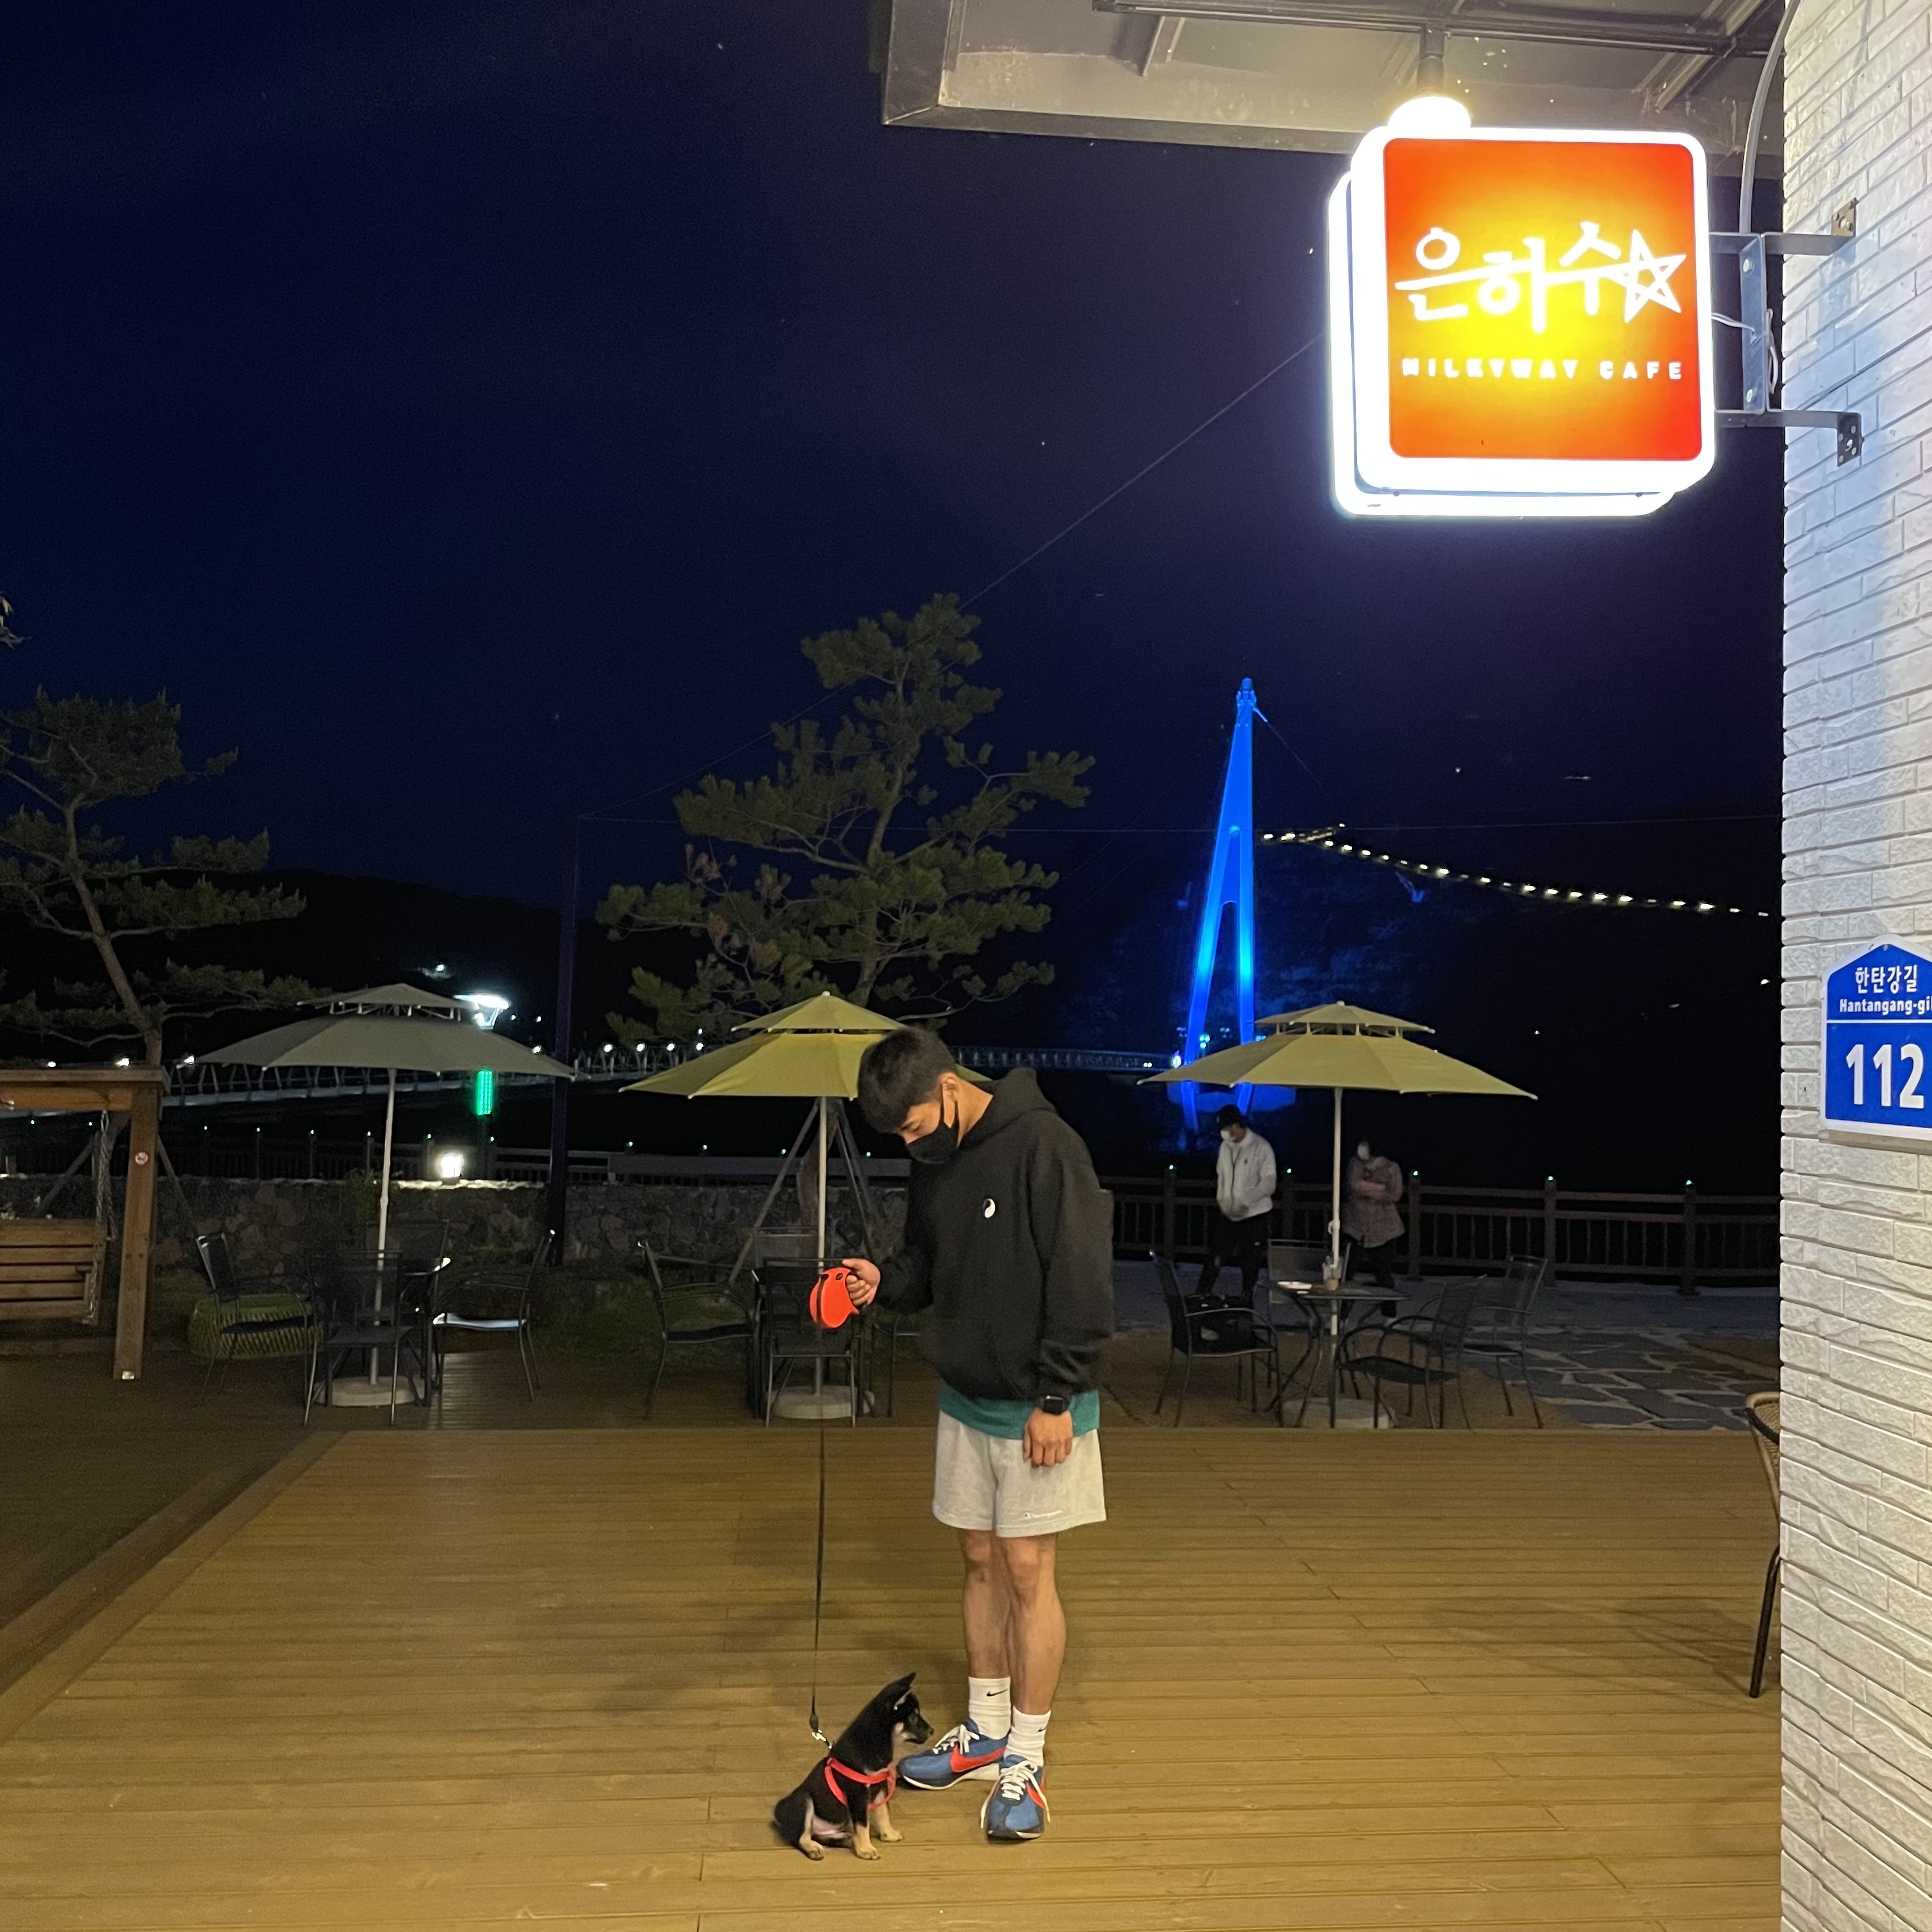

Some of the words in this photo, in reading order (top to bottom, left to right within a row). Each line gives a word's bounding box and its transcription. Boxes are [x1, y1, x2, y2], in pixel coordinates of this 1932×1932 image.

[1395, 221, 1623, 334] 은하수
[1402, 358, 1577, 379] MILKYWAY
[1599, 360, 1682, 379] CAFE
[1855, 964, 1917, 994] 한탄강길
[1846, 1043, 1924, 1109] 112
